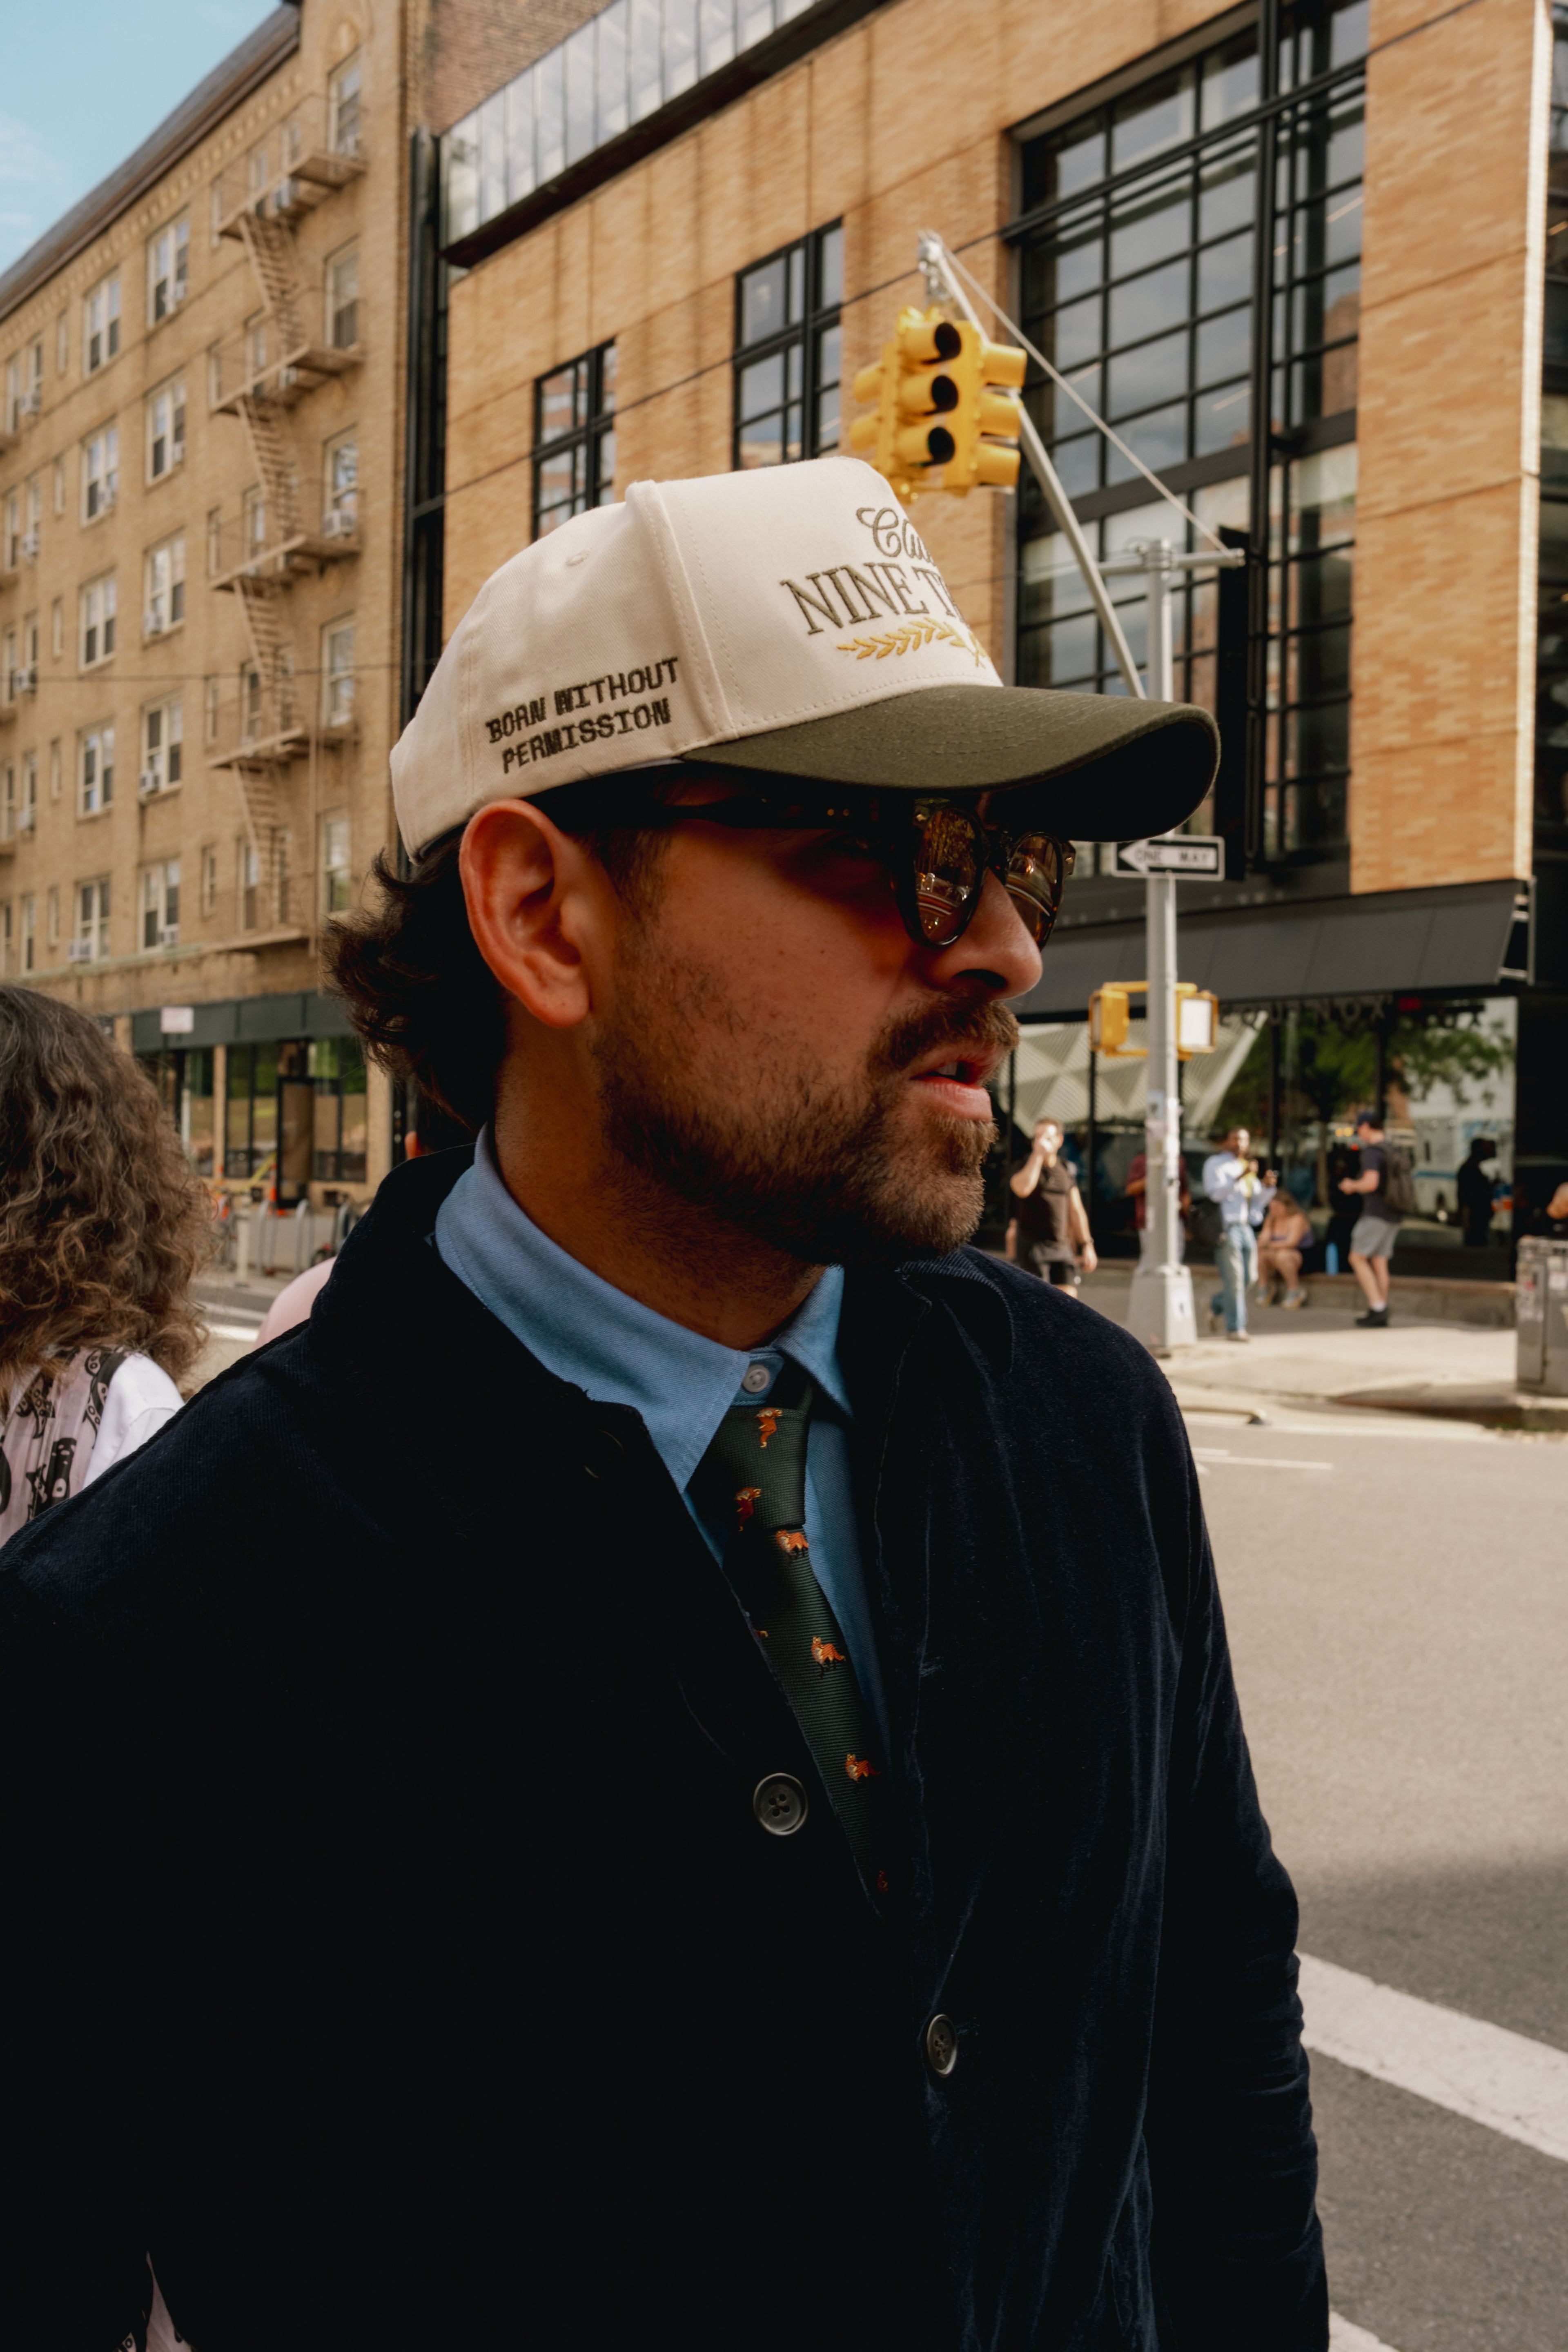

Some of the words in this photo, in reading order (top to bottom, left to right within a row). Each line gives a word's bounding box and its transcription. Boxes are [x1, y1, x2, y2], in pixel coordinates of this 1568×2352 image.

[485, 697, 547, 744] BORN
[554, 657, 678, 716] WITHOUT
[502, 697, 672, 774] PERMISSION
